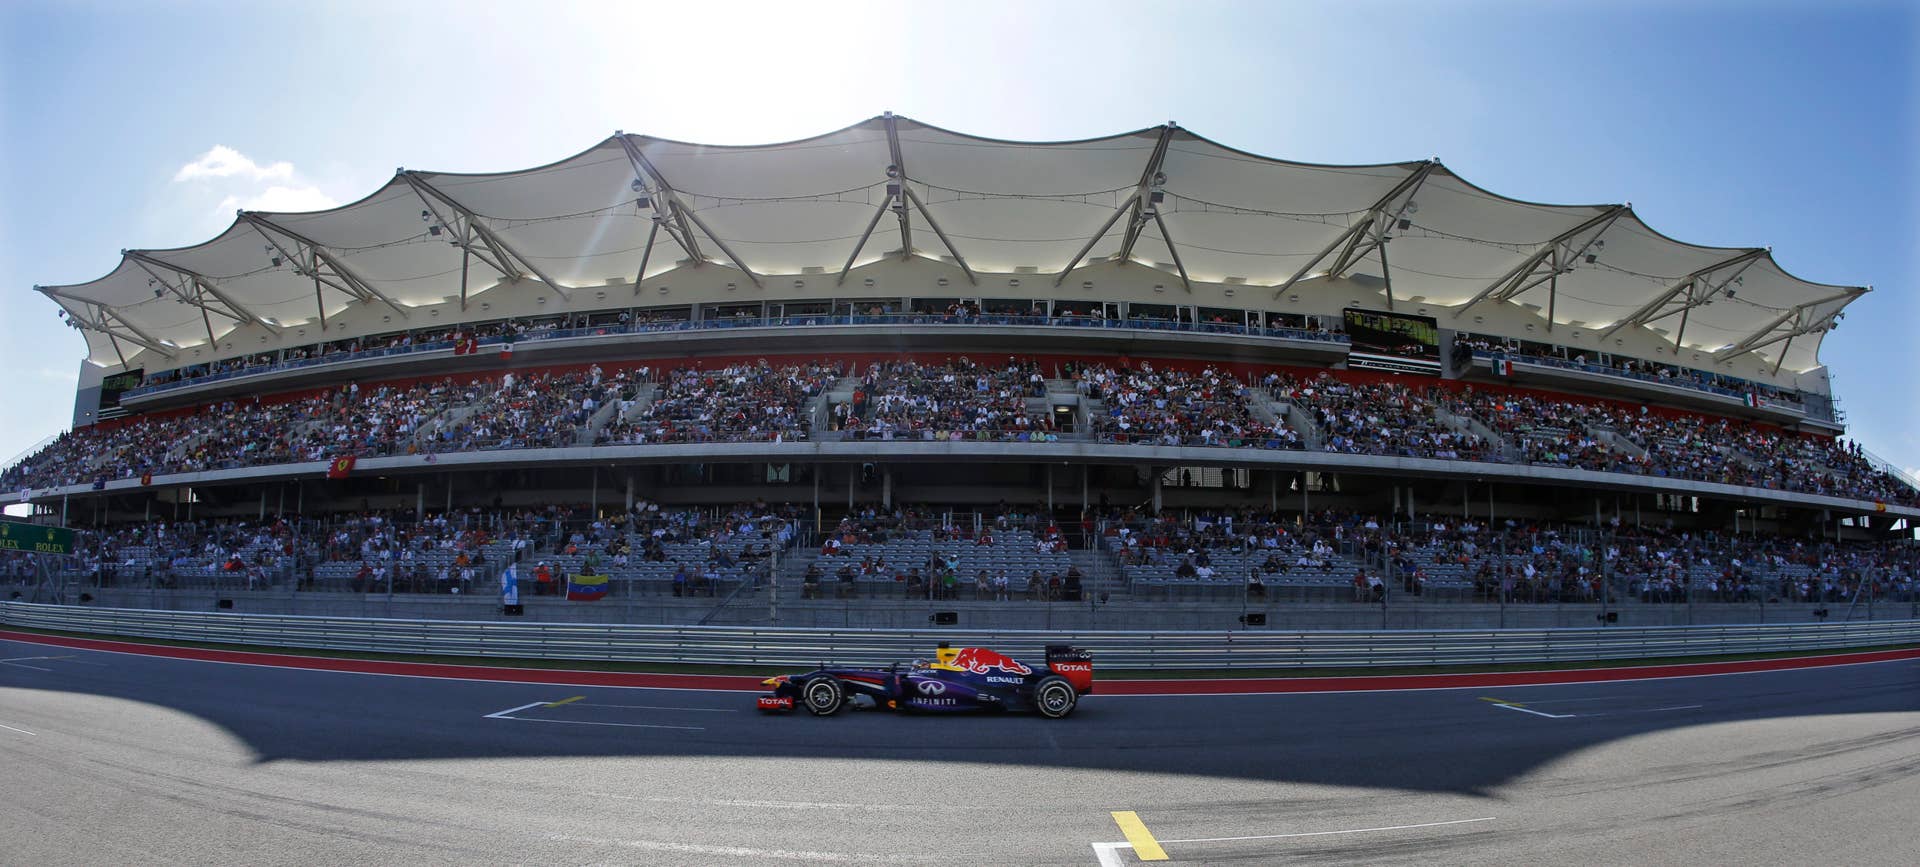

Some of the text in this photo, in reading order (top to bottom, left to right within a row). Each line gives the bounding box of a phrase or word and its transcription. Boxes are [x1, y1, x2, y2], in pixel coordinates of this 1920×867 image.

[35, 542, 64, 552] ROLEX
[1055, 663, 1091, 671] TOTAL
[986, 676, 1024, 684] RENAULT
[912, 697, 956, 705] INFINITI
